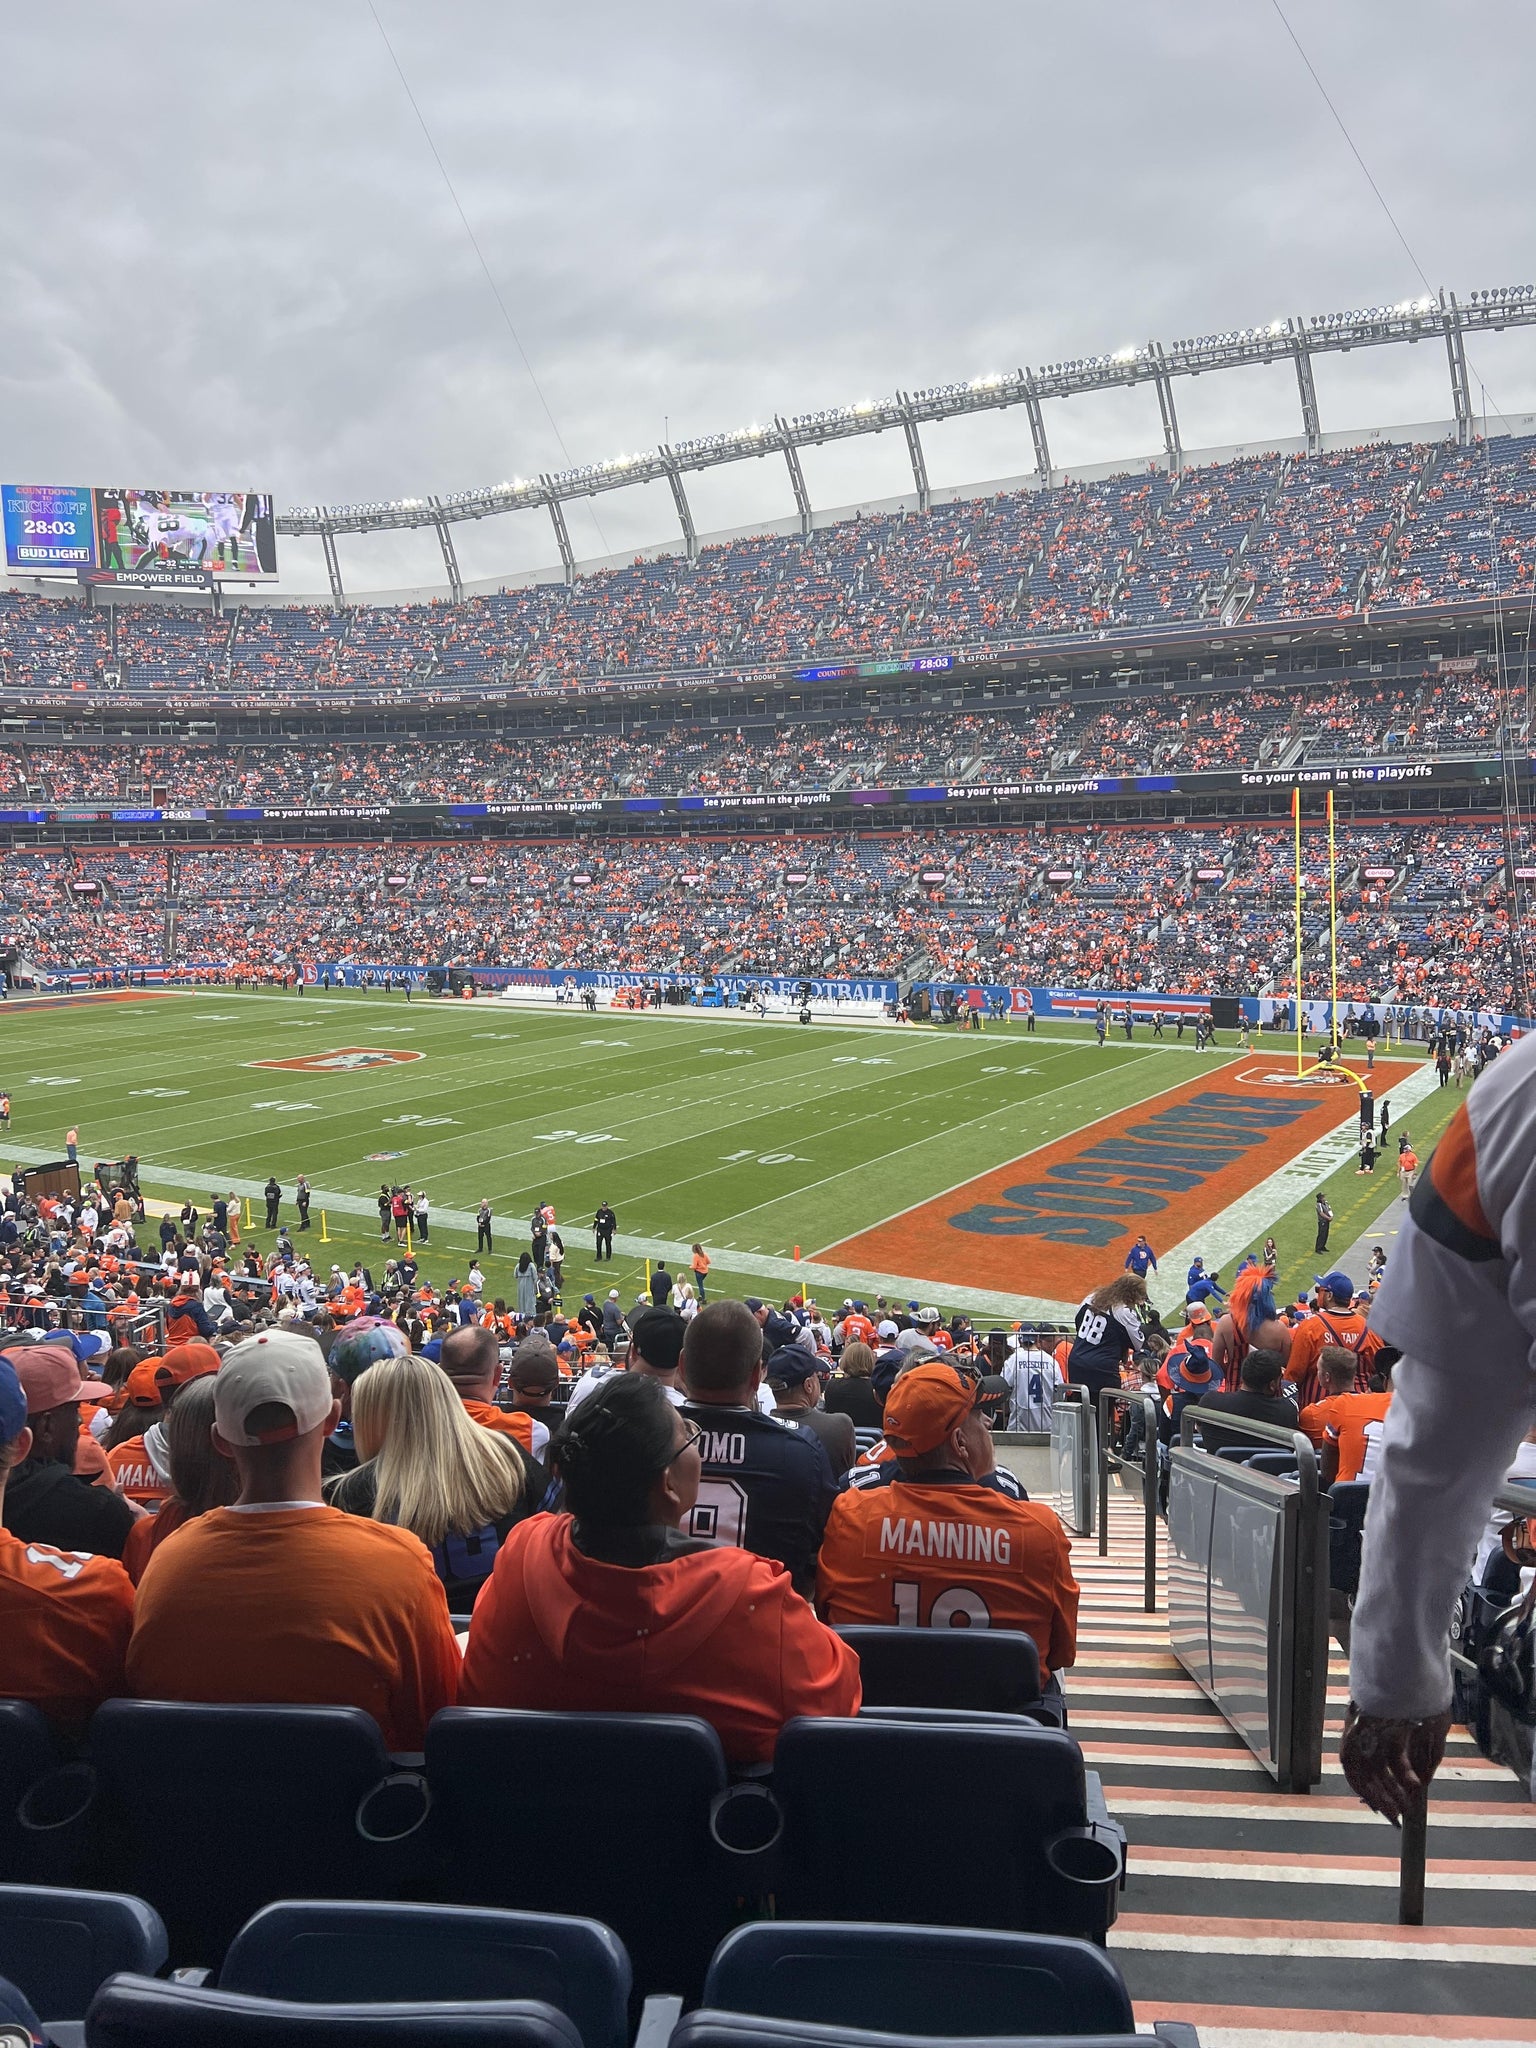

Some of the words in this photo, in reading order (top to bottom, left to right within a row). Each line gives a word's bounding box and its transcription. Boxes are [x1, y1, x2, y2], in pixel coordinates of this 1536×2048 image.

[16, 487, 77, 496] COUNTDOWN
[7, 499, 87, 515] KICKOFF
[24, 520, 76, 535] 28:03
[20, 548, 48, 558] BUD
[49, 549, 86, 559] LIGHT
[116, 573, 173, 583] EMPOWER
[175, 574, 205, 583] FIELD
[920, 658, 949, 669] 28:03
[975, 653, 999, 661] FOLEY
[1441, 660, 1476, 669] RESPECT
[683, 678, 715, 687] SHANAHAN
[1241, 773, 1262, 784] See
[1265, 773, 1295, 786] your
[1298, 771, 1331, 781] team
[1336, 769, 1348, 779] in
[1352, 767, 1374, 778] the
[1377, 765, 1432, 780] playoffs
[947, 788, 964, 797] See
[967, 787, 990, 798] your
[992, 785, 1019, 795] team
[1022, 784, 1032, 793] in
[1034, 783, 1053, 793] the
[1055, 780, 1099, 794] playoffs
[703, 798, 718, 806] See
[720, 798, 741, 808] your
[742, 797, 765, 805] team
[767, 796, 775, 804] in
[776, 795, 792, 804] the
[795, 793, 831, 805] playoffs
[161, 810, 192, 819] 28:03
[263, 809, 280, 817] See
[282, 809, 303, 818] your
[304, 808, 327, 816] team
[329, 808, 338, 816] in
[339, 808, 354, 816] the
[357, 807, 390, 817] playoffs
[486, 805, 501, 813] See
[502, 804, 520, 814] your
[545, 803, 553, 811] in
[554, 803, 568, 811] the
[570, 802, 602, 813] playoffs
[382, 1114, 453, 1126] 30
[532, 1130, 613, 1144] 20
[718, 1149, 796, 1165] 10
[1283, 1150, 1346, 1178] LOVE
[947, 1092, 1324, 1247] BRONCOS
[1078, 1308, 1108, 1346] 88
[1018, 1360, 1049, 1370] PRESCOTT
[1028, 1374, 1044, 1404] 4
[699, 1432, 746, 1465] OMO
[880, 1517, 1011, 1565] MANNING
